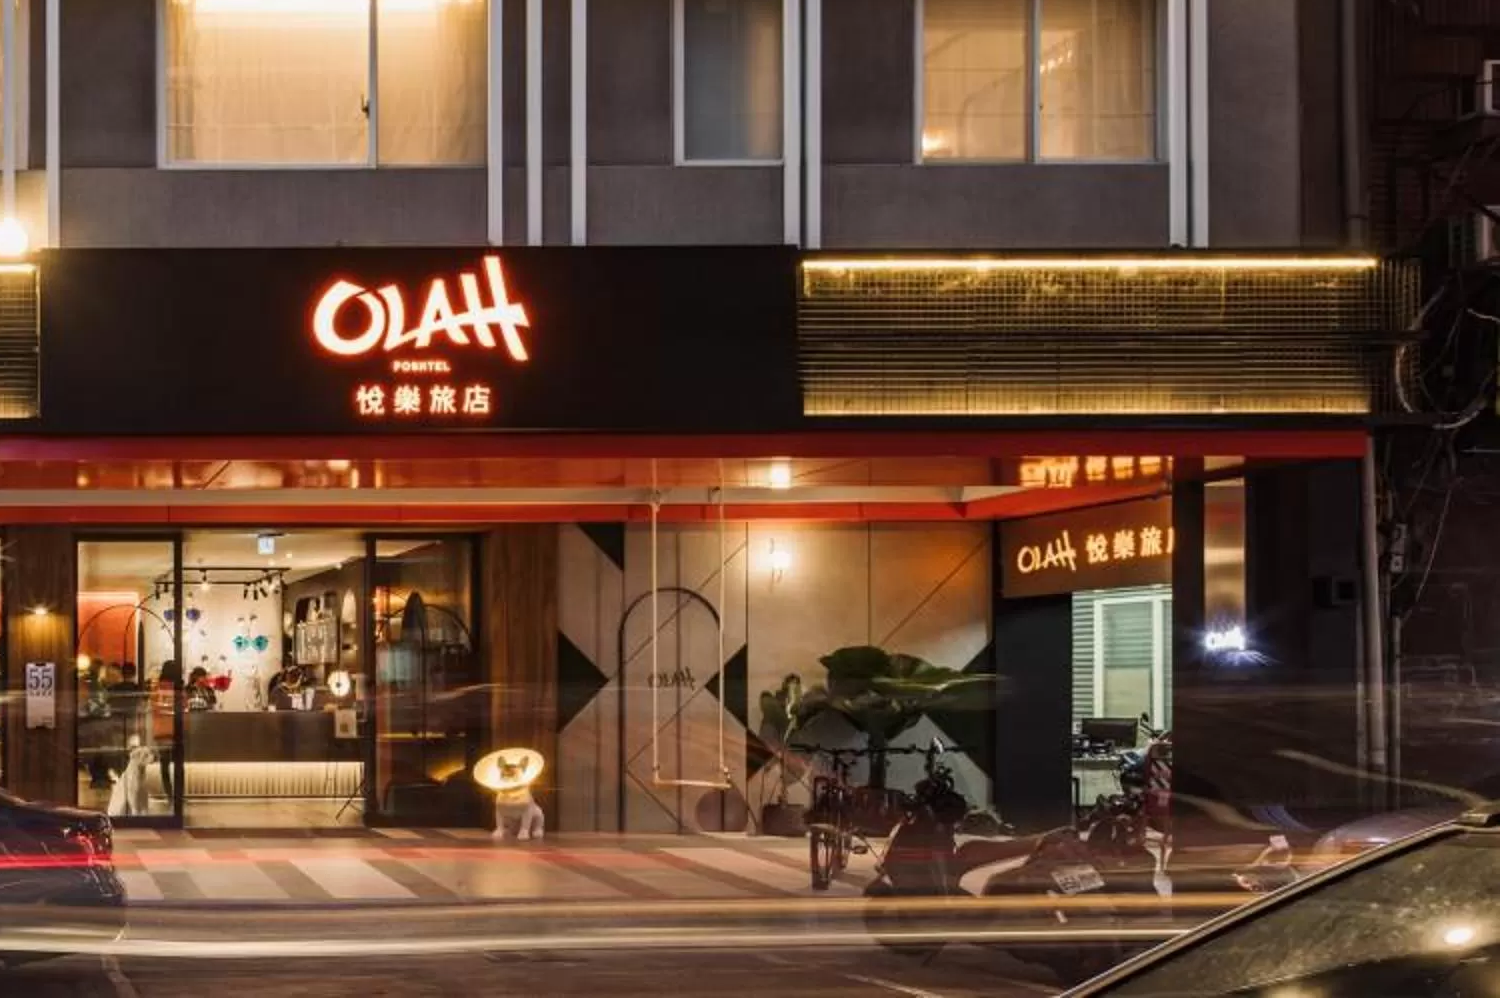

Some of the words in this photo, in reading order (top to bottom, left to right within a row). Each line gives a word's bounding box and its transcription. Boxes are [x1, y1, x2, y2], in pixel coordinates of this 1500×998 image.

[313, 255, 530, 362] OLAH
[1017, 530, 1077, 574] OLAH
[29, 667, 53, 690] 55
